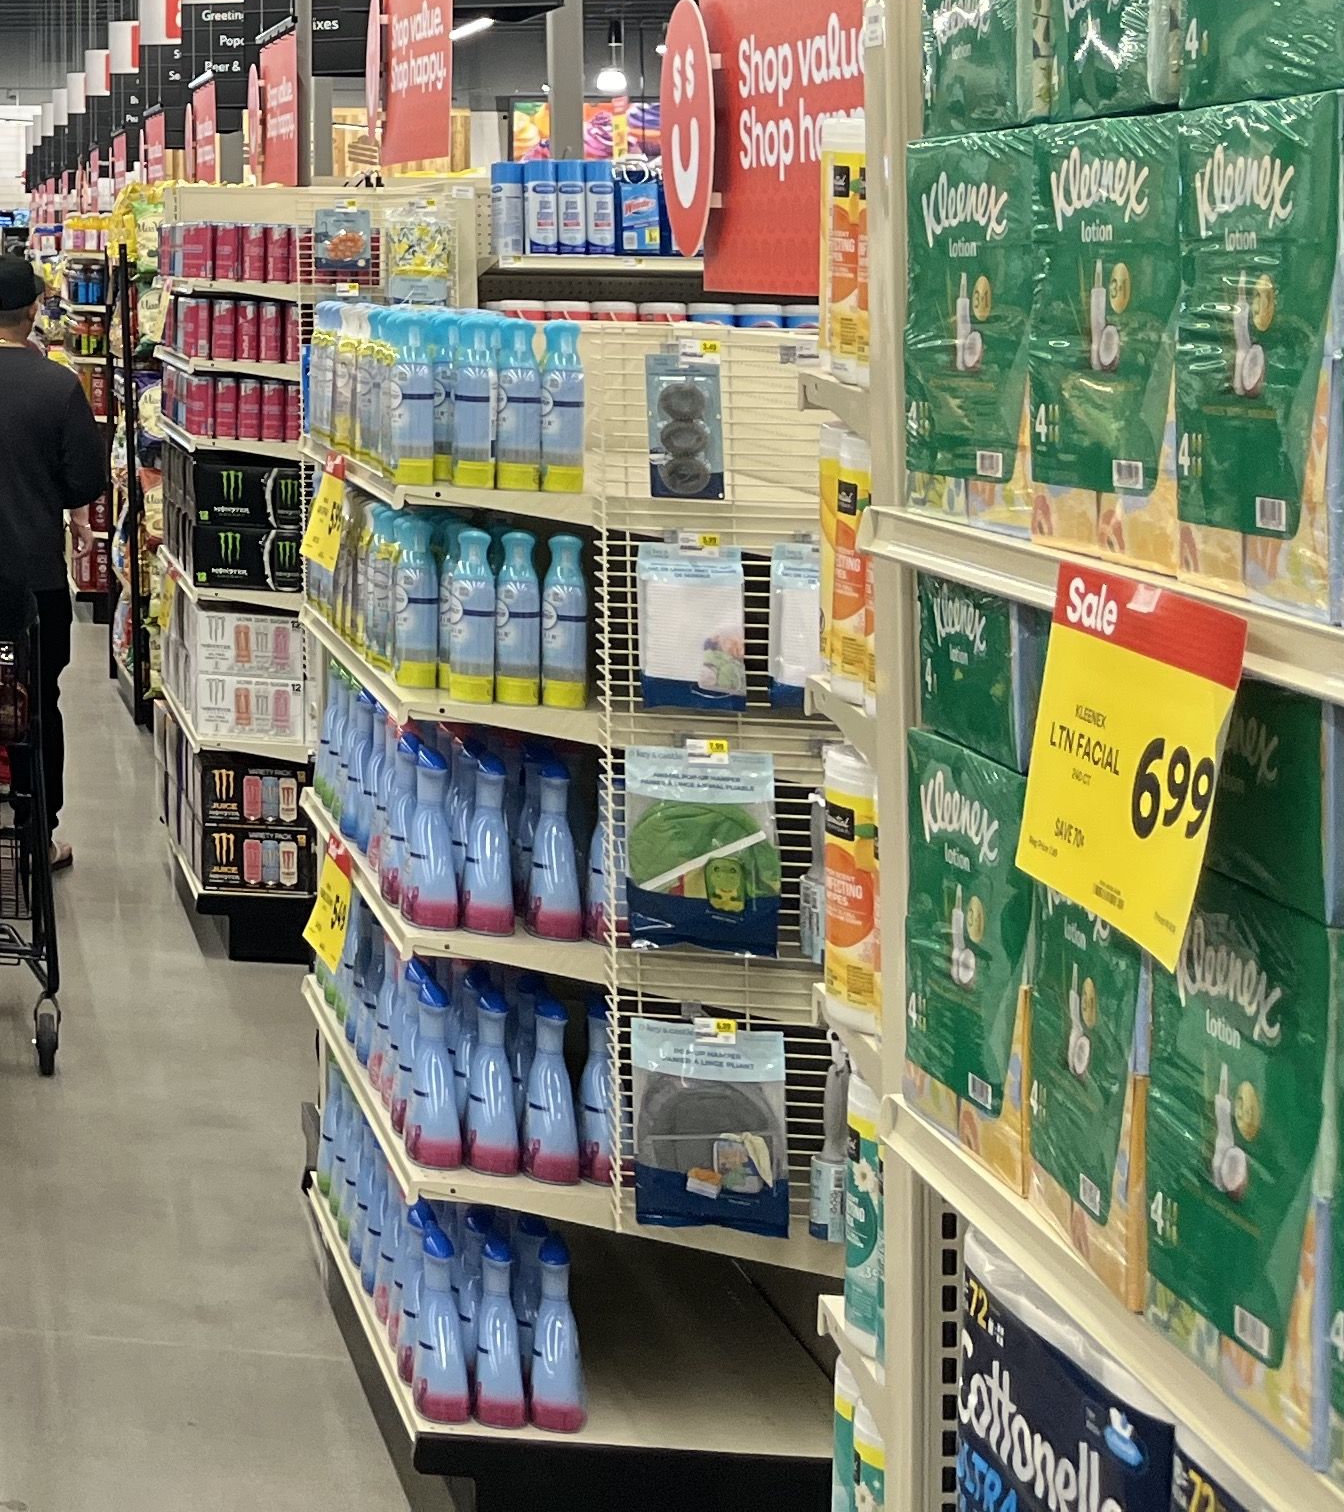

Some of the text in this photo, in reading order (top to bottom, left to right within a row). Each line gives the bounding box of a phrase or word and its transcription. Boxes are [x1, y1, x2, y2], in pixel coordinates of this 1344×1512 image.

[312, 19, 340, 31] ixes
[738, 34, 793, 107] Shop
[739, 106, 794, 181] Shop
[922, 170, 1008, 248] Kleenex
[1050, 146, 1149, 232] Kleenex
[1196, 143, 1295, 237] Kleenex
[949, 238, 977, 258] lotion
[1081, 220, 1113, 243] lotion
[1225, 228, 1257, 251] lotion
[1035, 403, 1048, 443] 4
[1178, 432, 1191, 476] 4
[933, 582, 986, 656] Kleenex
[1066, 577, 1118, 636] Sale
[291, 683, 302, 693] 12
[1075, 703, 1107, 729] KLEENEX
[1049, 721, 1120, 776] LTN FACIAL
[1130, 737, 1216, 840] 699
[920, 769, 999, 863] Kleenex
[1054, 817, 1074, 844] SAVE
[945, 842, 971, 872] lotion
[1176, 916, 1283, 1041] Kleenex
[908, 991, 918, 1028] 4
[1205, 1008, 1242, 1050] lotion
[1150, 1191, 1165, 1236] 4
[969, 1278, 990, 1330] 72
